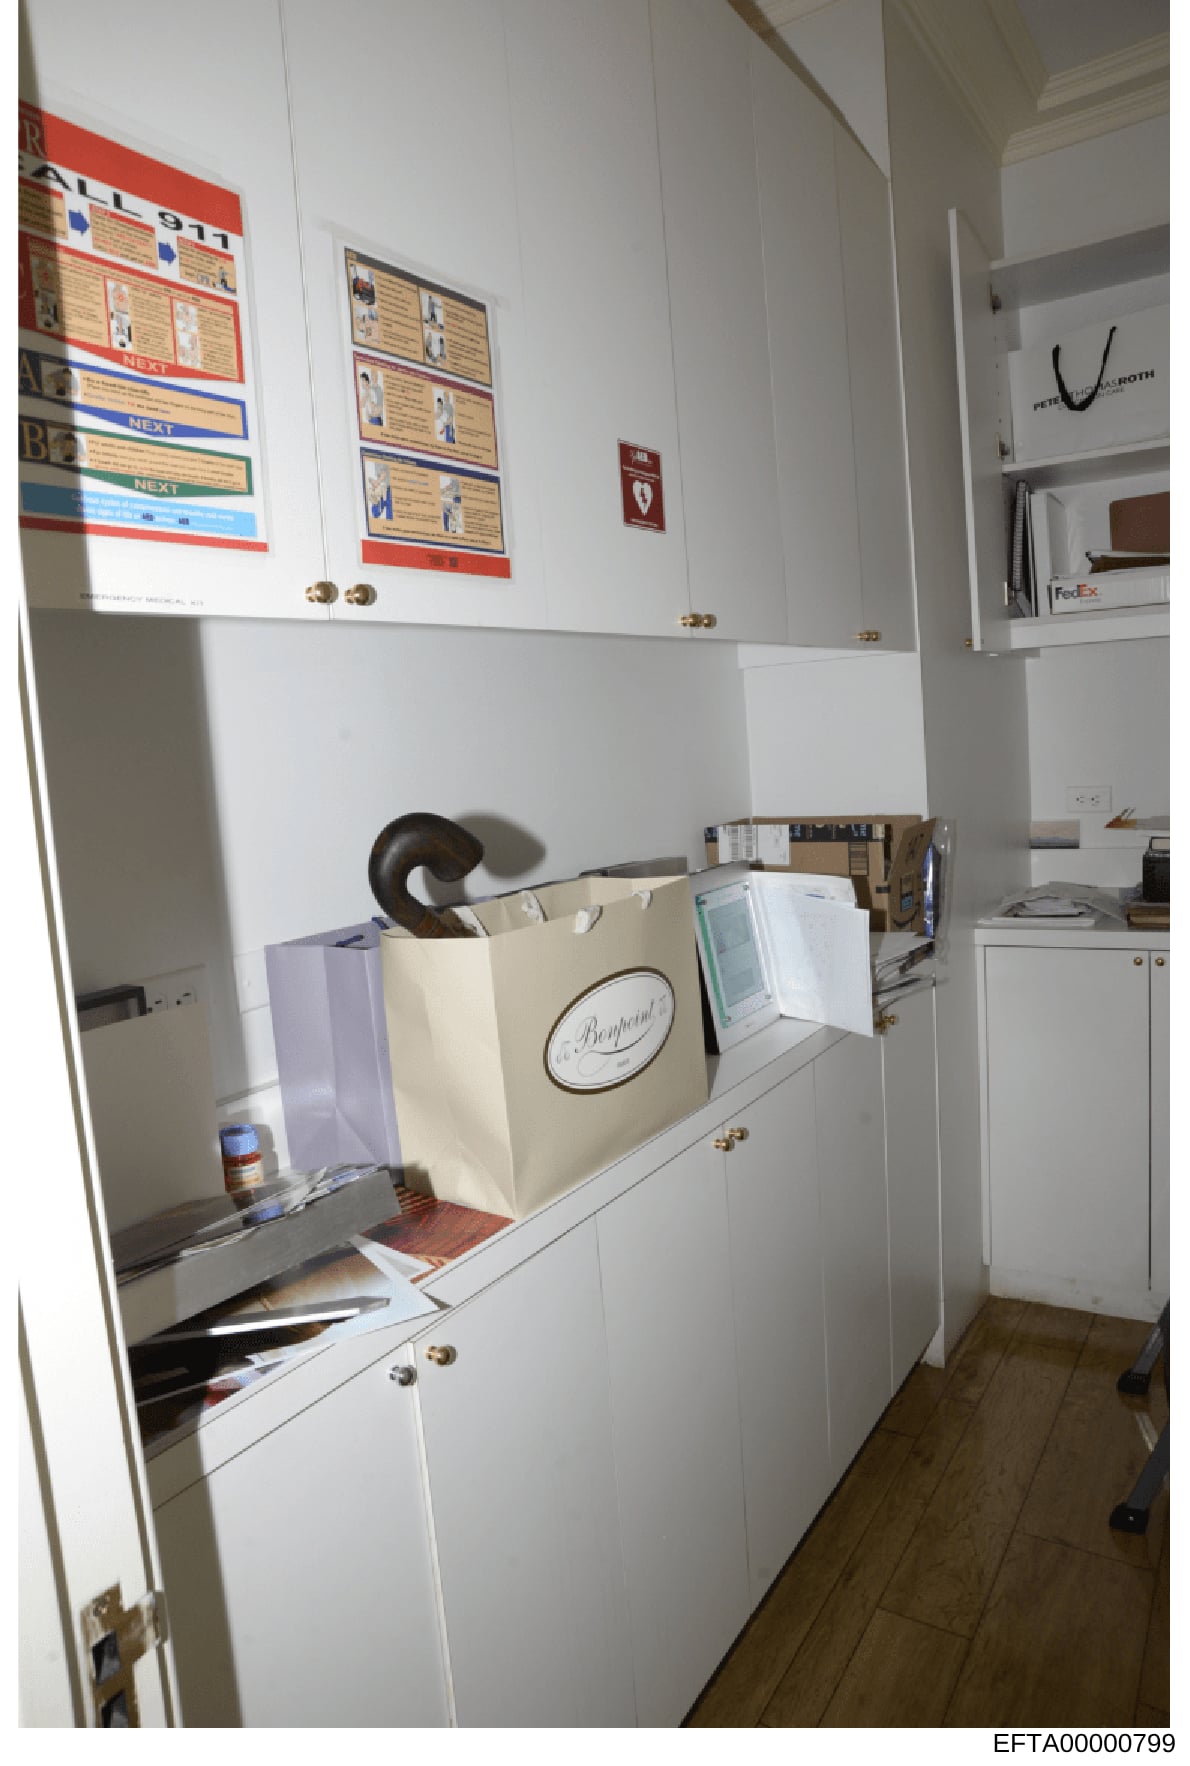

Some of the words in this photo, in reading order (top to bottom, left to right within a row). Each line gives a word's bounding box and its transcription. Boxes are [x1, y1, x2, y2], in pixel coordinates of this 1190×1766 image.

[18, 154, 144, 218] ALL
[158, 211, 229, 250] 911
[123, 352, 169, 376] NEXT
[128, 416, 174, 435] NEXT
[22, 421, 48, 460] B
[134, 479, 179, 495] NEXT
[80, 592, 141, 603] EMERGENCY
[145, 596, 186, 606] MEDICAL
[1055, 584, 1098, 600] FedEx
[575, 998, 657, 1053] Bonpoint
